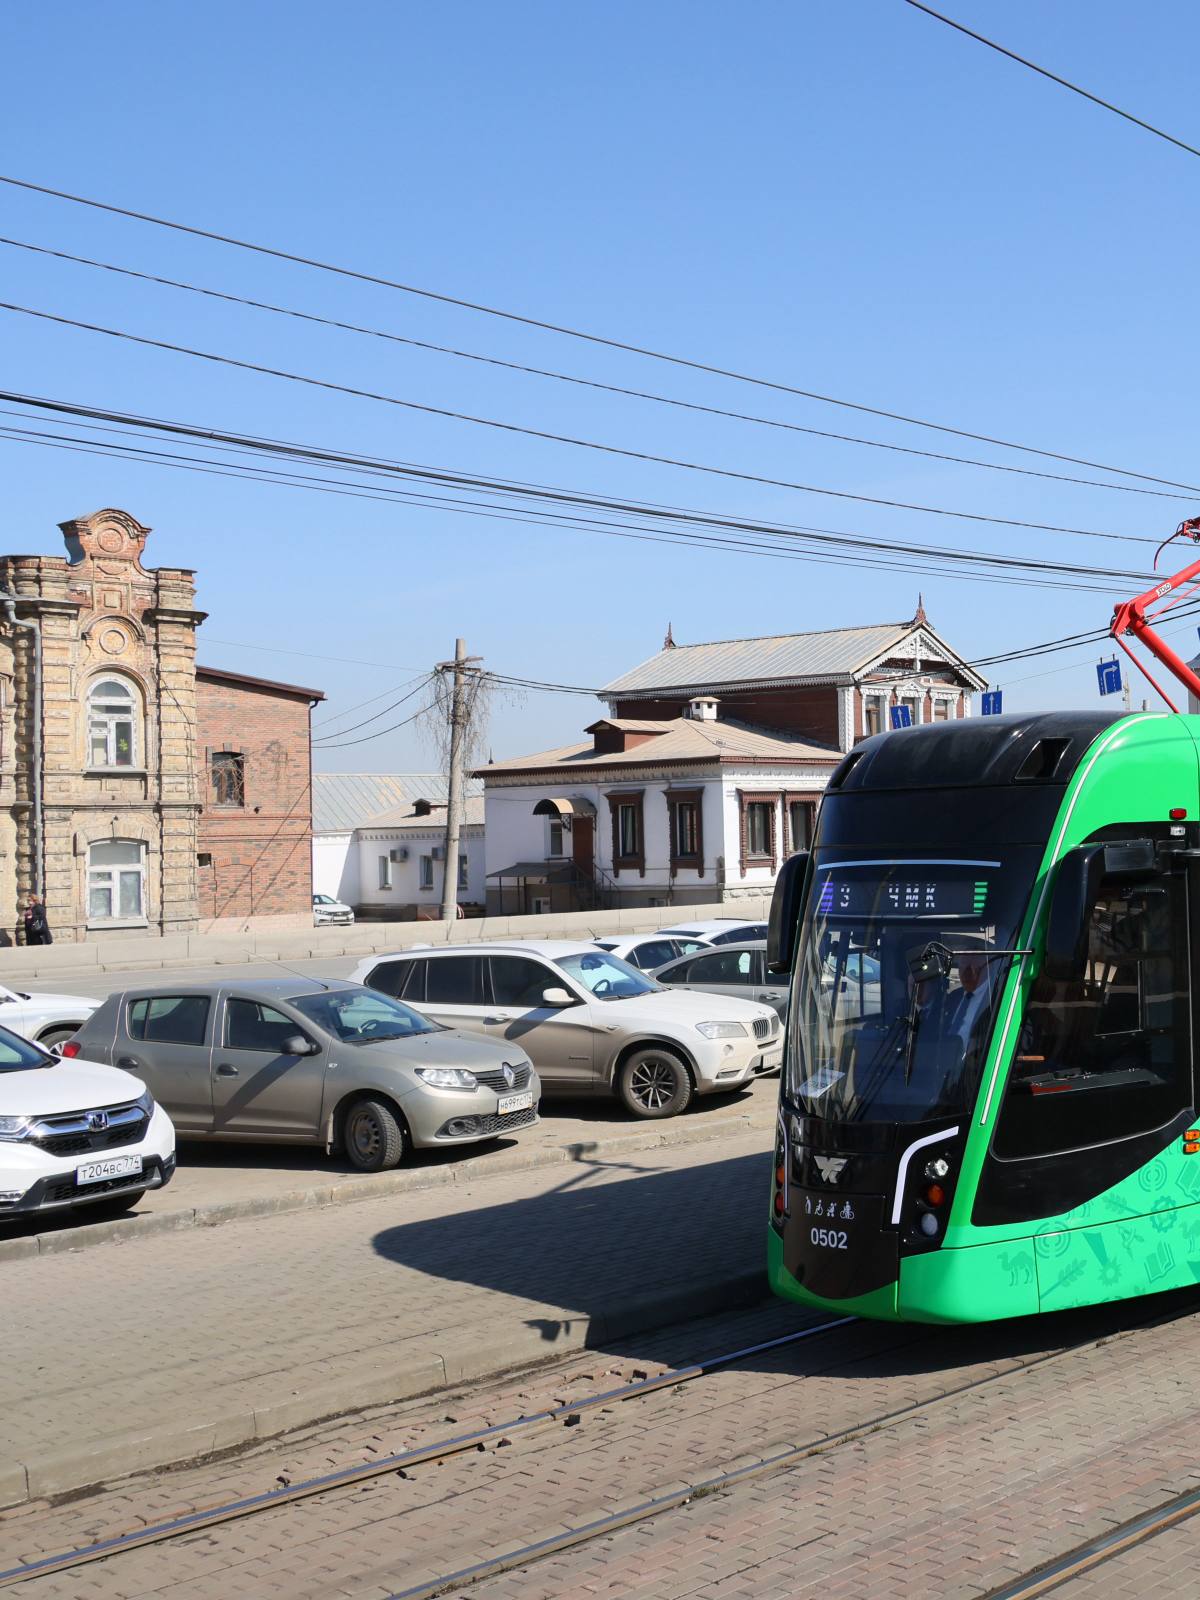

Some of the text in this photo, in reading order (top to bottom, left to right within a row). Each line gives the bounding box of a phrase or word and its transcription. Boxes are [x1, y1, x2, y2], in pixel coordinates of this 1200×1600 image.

[840, 883, 937, 908] 3 ЧМК
[810, 1227, 848, 1250] 0502
